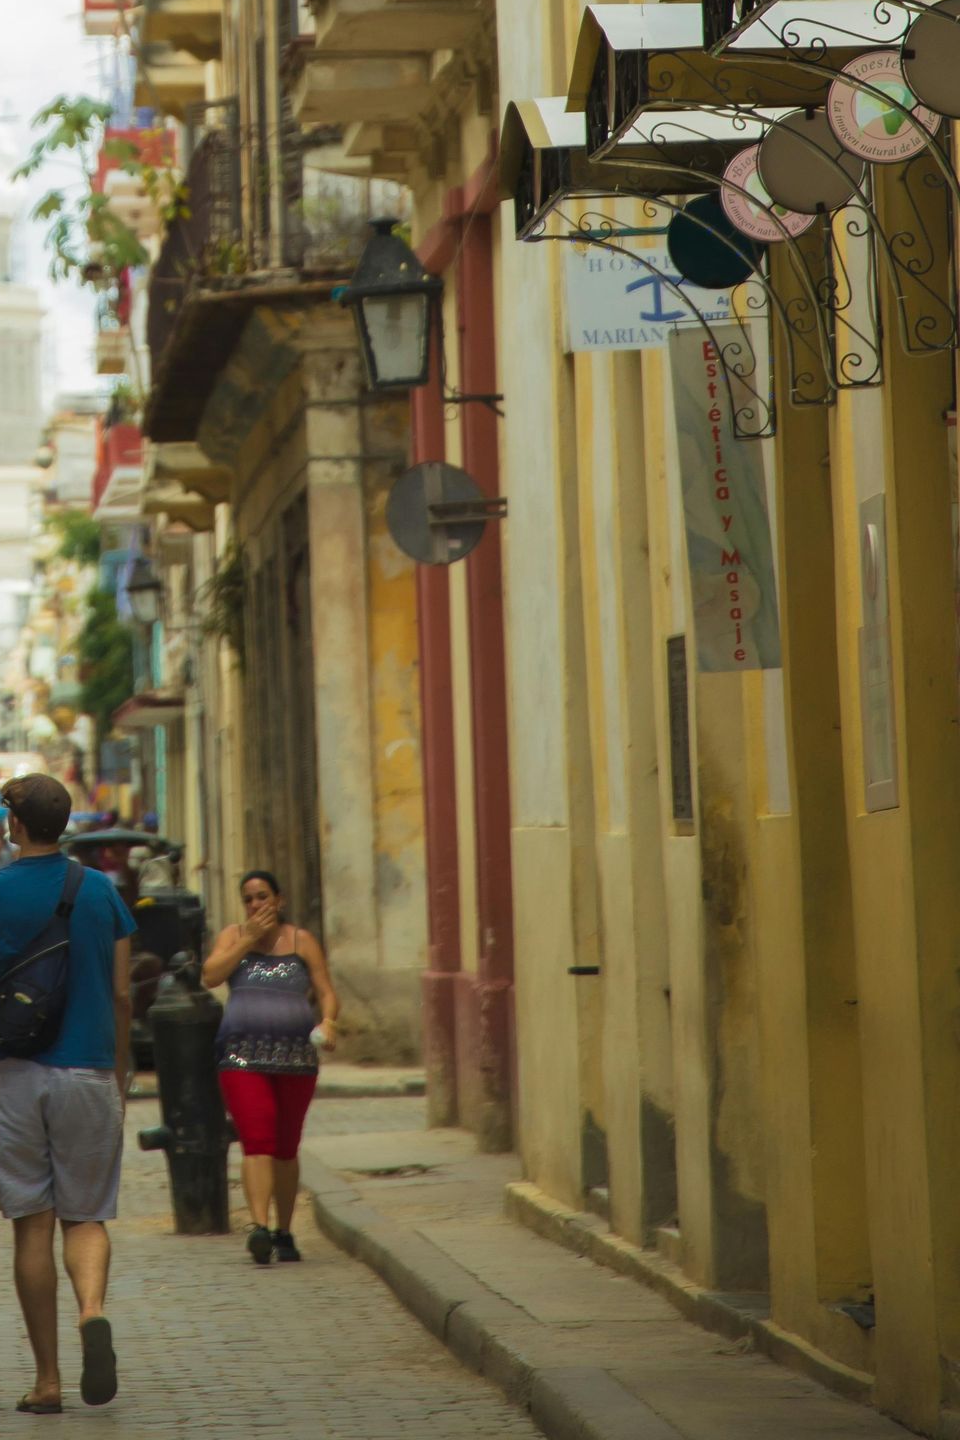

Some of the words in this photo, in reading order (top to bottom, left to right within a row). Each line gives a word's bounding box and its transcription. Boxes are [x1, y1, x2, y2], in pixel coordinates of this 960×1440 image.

[835, 115, 859, 145] imagen
[860, 144, 897, 156] natural
[901, 143, 910, 153] de
[911, 136, 921, 147] la
[731, 206, 755, 231] imagen
[702, 340, 730, 501] Estética
[721, 515, 732, 532] y
[721, 545, 746, 661] Masaje
